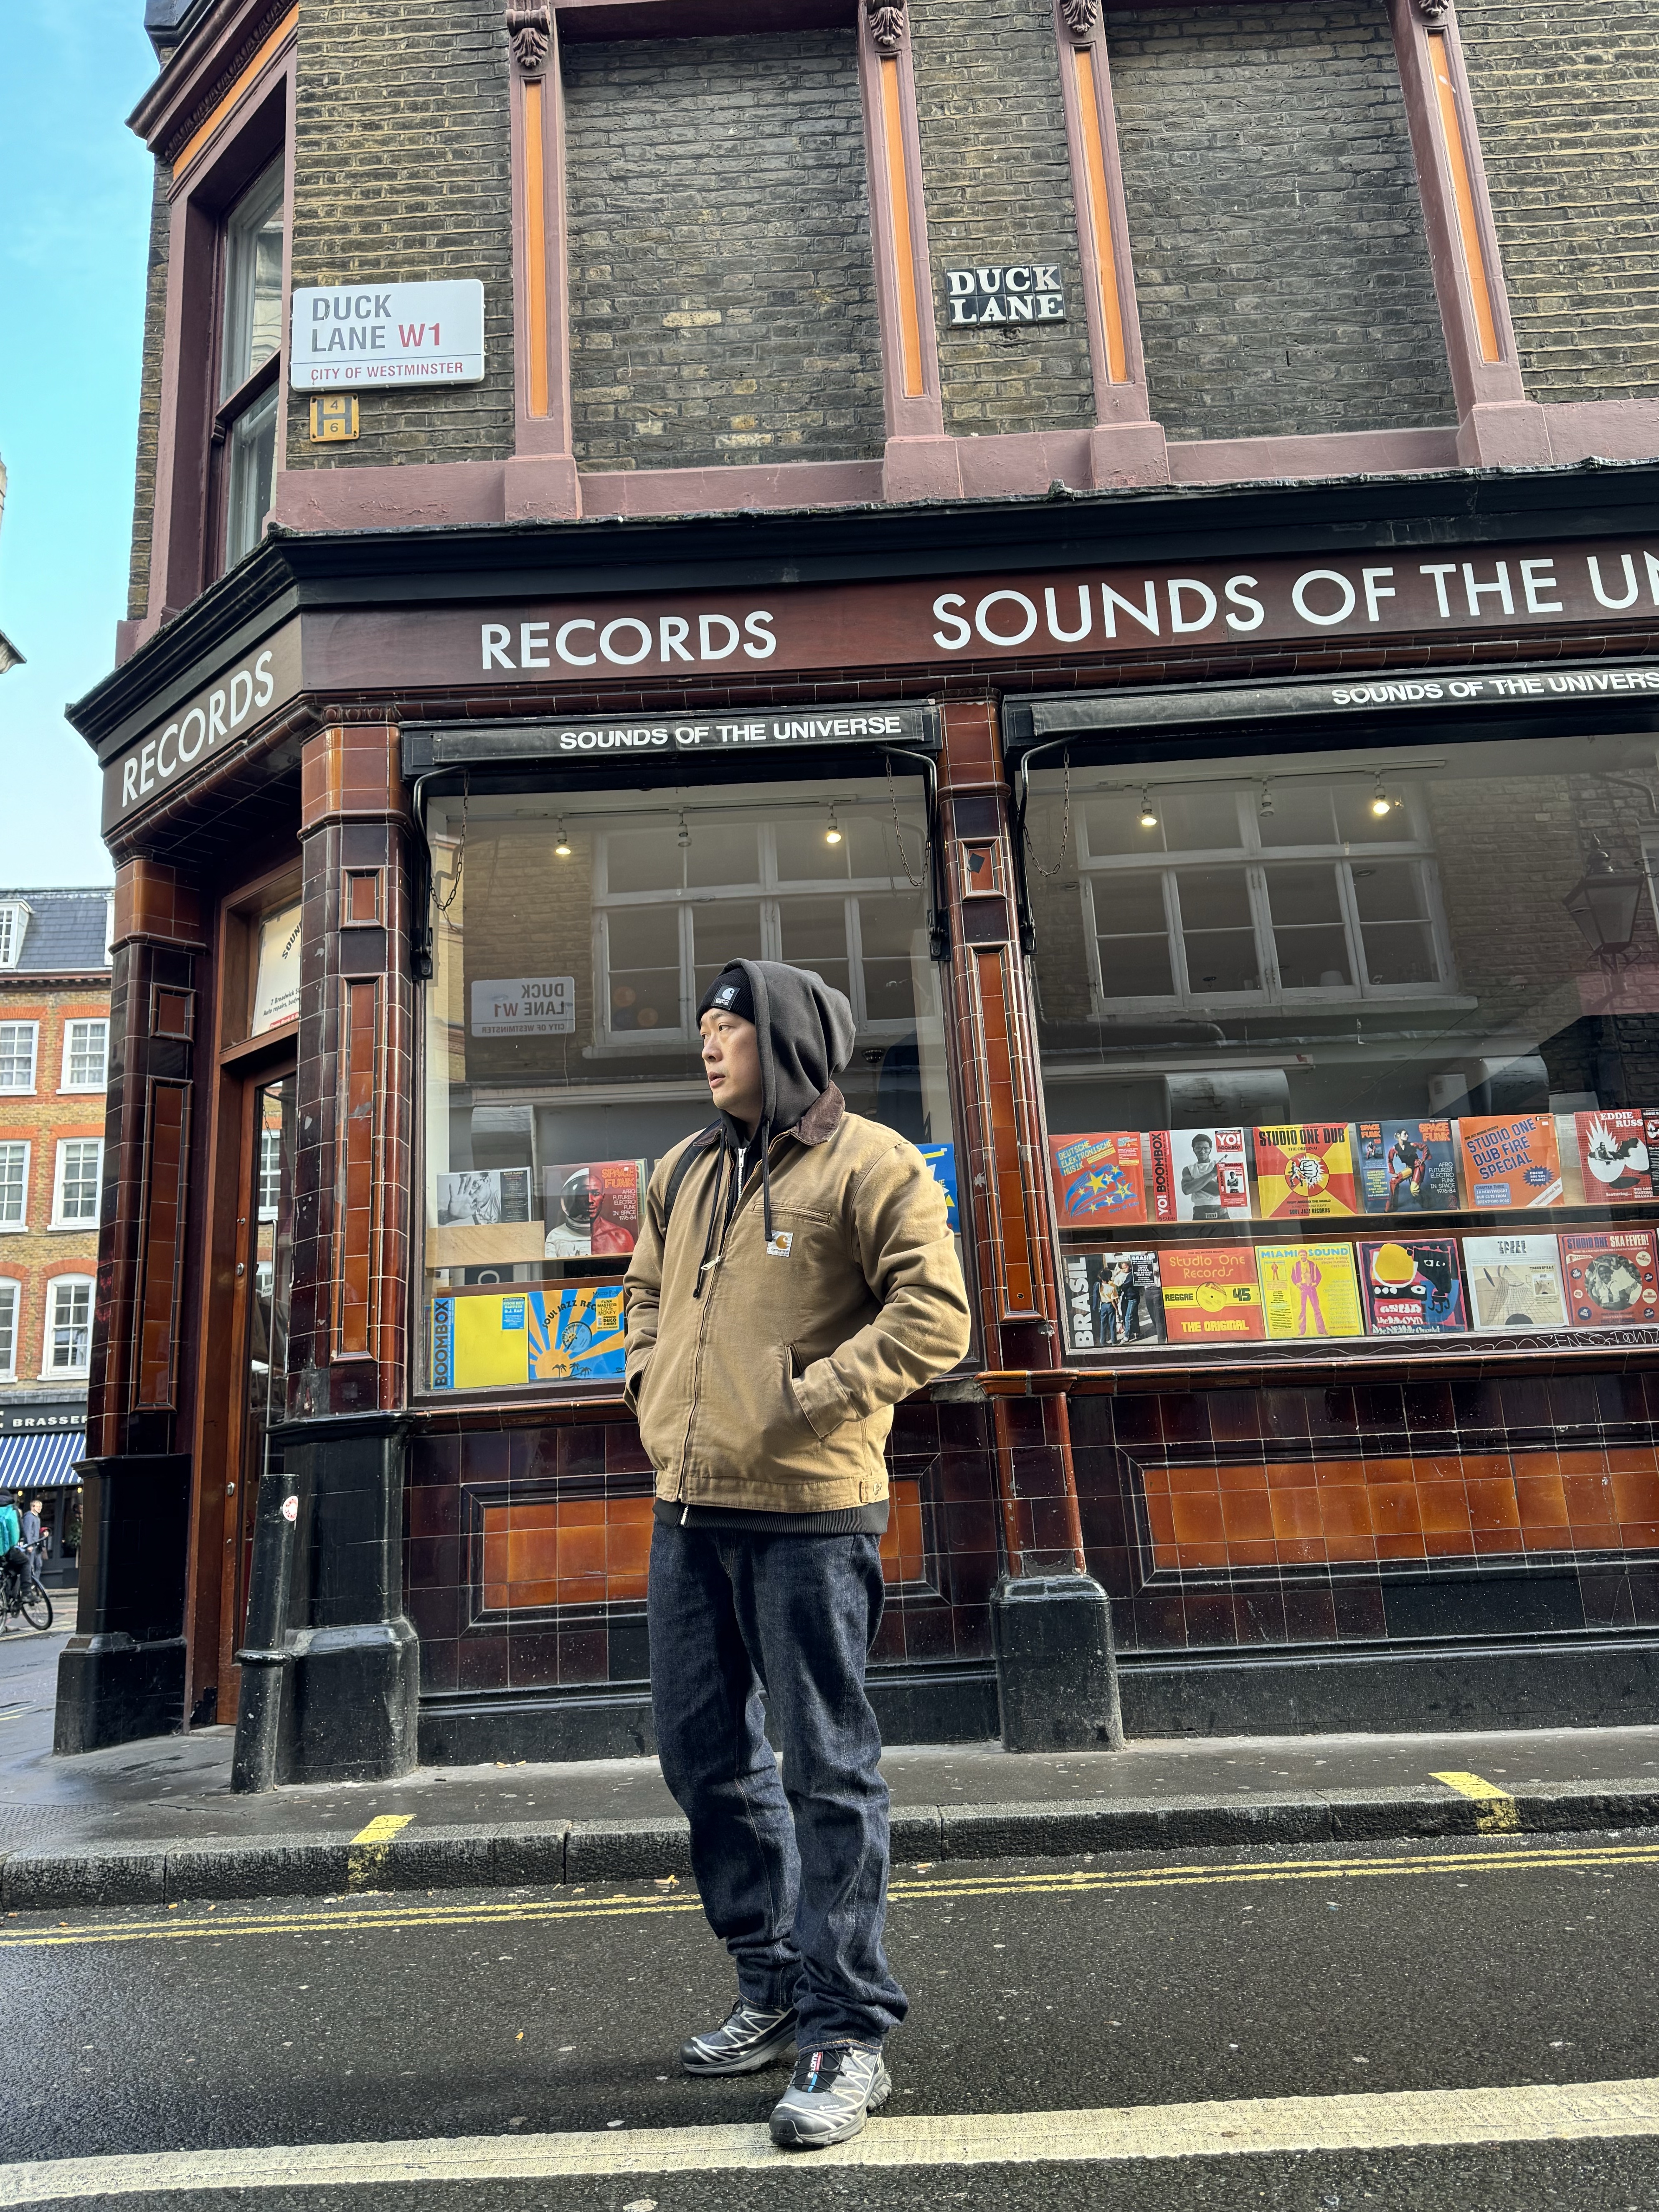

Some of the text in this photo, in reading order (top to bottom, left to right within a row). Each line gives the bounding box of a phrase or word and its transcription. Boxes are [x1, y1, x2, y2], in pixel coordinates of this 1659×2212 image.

[947, 266, 1060, 295] DUCK
[312, 294, 392, 321] DUCK
[950, 294, 1063, 322] LANE
[312, 323, 441, 352] LANE W1
[311, 362, 463, 380] CITY OF WESTMINSTER
[330, 401, 338, 409] 4
[317, 396, 352, 436] H
[330, 423, 338, 432] 6
[933, 559, 1563, 649] SOUNDS OF THE
[482, 611, 777, 669] RECORDS
[1332, 671, 1659, 705] SOUNDS OF THE UNIVERS
[122, 650, 274, 807] RECORDS
[560, 716, 902, 749] SOUNDS OF THE UNIVERSE
[274, 989, 294, 1004] Broadwick
[273, 1002, 287, 1012] repairs,
[1600, 1112, 1634, 1120] EDDIE
[1259, 1127, 1345, 1146] STUDIO ONE DUB
[1419, 1122, 1449, 1132] SPACE
[1422, 1132, 1451, 1142] FUNK
[1467, 1118, 1536, 1153] STUDIO ONE
[1216, 1133, 1241, 1146] YO!
[1059, 1140, 1091, 1160] DEUTSCHE
[1061, 1139, 1114, 1168] ELEKTRONISCHE
[1472, 1136, 1530, 1167] DUB FIRE
[1063, 1161, 1084, 1176] MUSIK
[1152, 1132, 1166, 1192] BOOMBOX
[1479, 1151, 1533, 1180] SPECIAL
[601, 1167, 634, 1178] SPACE
[605, 1177, 635, 1188] FUNK
[1157, 1195, 1168, 1216] YO!
[1567, 1234, 1649, 1249] STUDIO ONE SKA FEVER!
[1169, 1254, 1246, 1266] Studio One
[1261, 1248, 1349, 1259] MIAMI SOUND
[1184, 1266, 1234, 1279] Records
[1068, 1257, 1094, 1347] BRASIL
[1165, 1288, 1251, 1301] REGGAE 45
[542, 1300, 596, 1329] SOUL JAZZ REC
[1181, 1320, 1250, 1332] THE ORIGINAL
[434, 1299, 449, 1386] BOOMBOX
